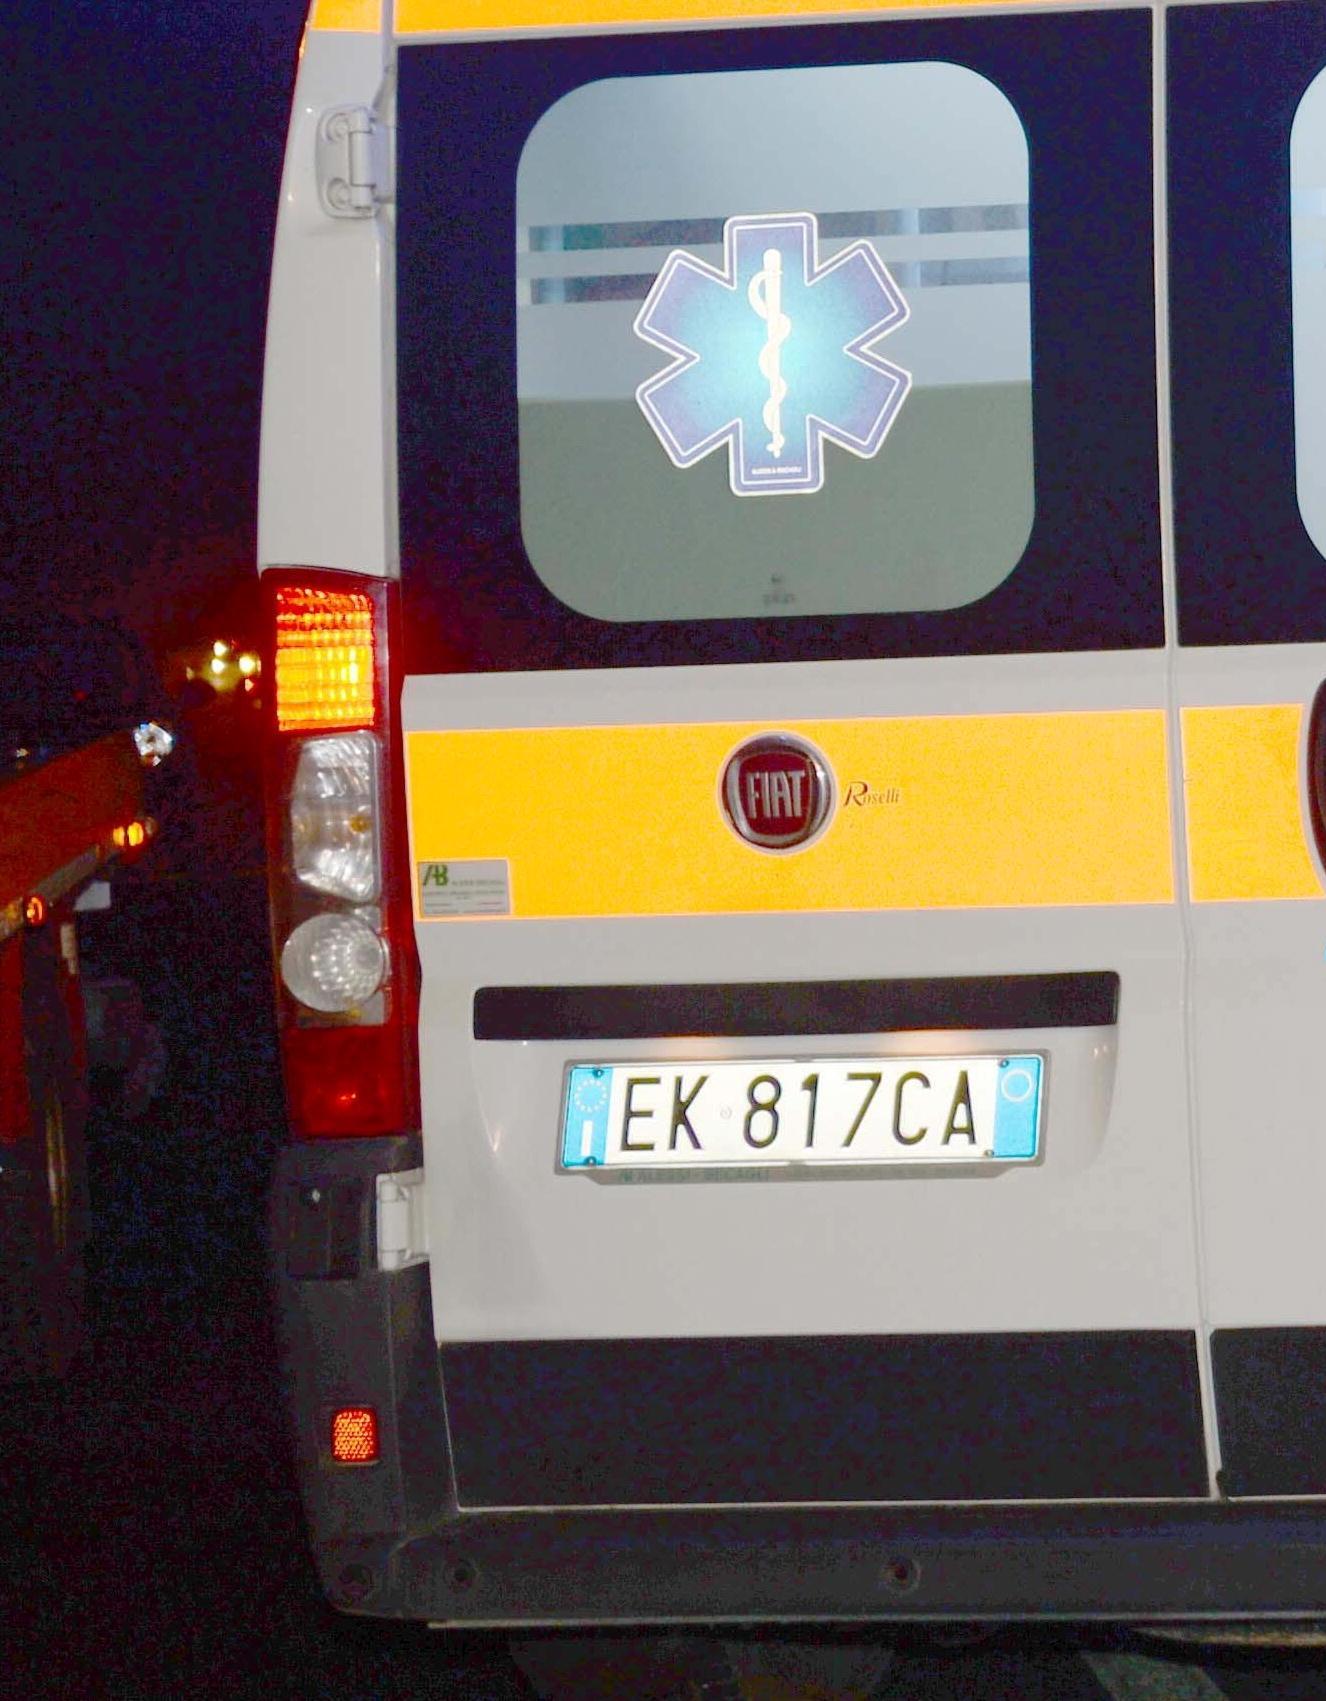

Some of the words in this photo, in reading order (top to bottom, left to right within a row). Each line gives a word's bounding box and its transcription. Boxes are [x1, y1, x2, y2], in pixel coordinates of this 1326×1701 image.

[746, 769, 806, 820] FIAT
[843, 780, 900, 808] Roselli
[620, 1074, 709, 1152] EK
[743, 1070, 977, 1149] 817CA
